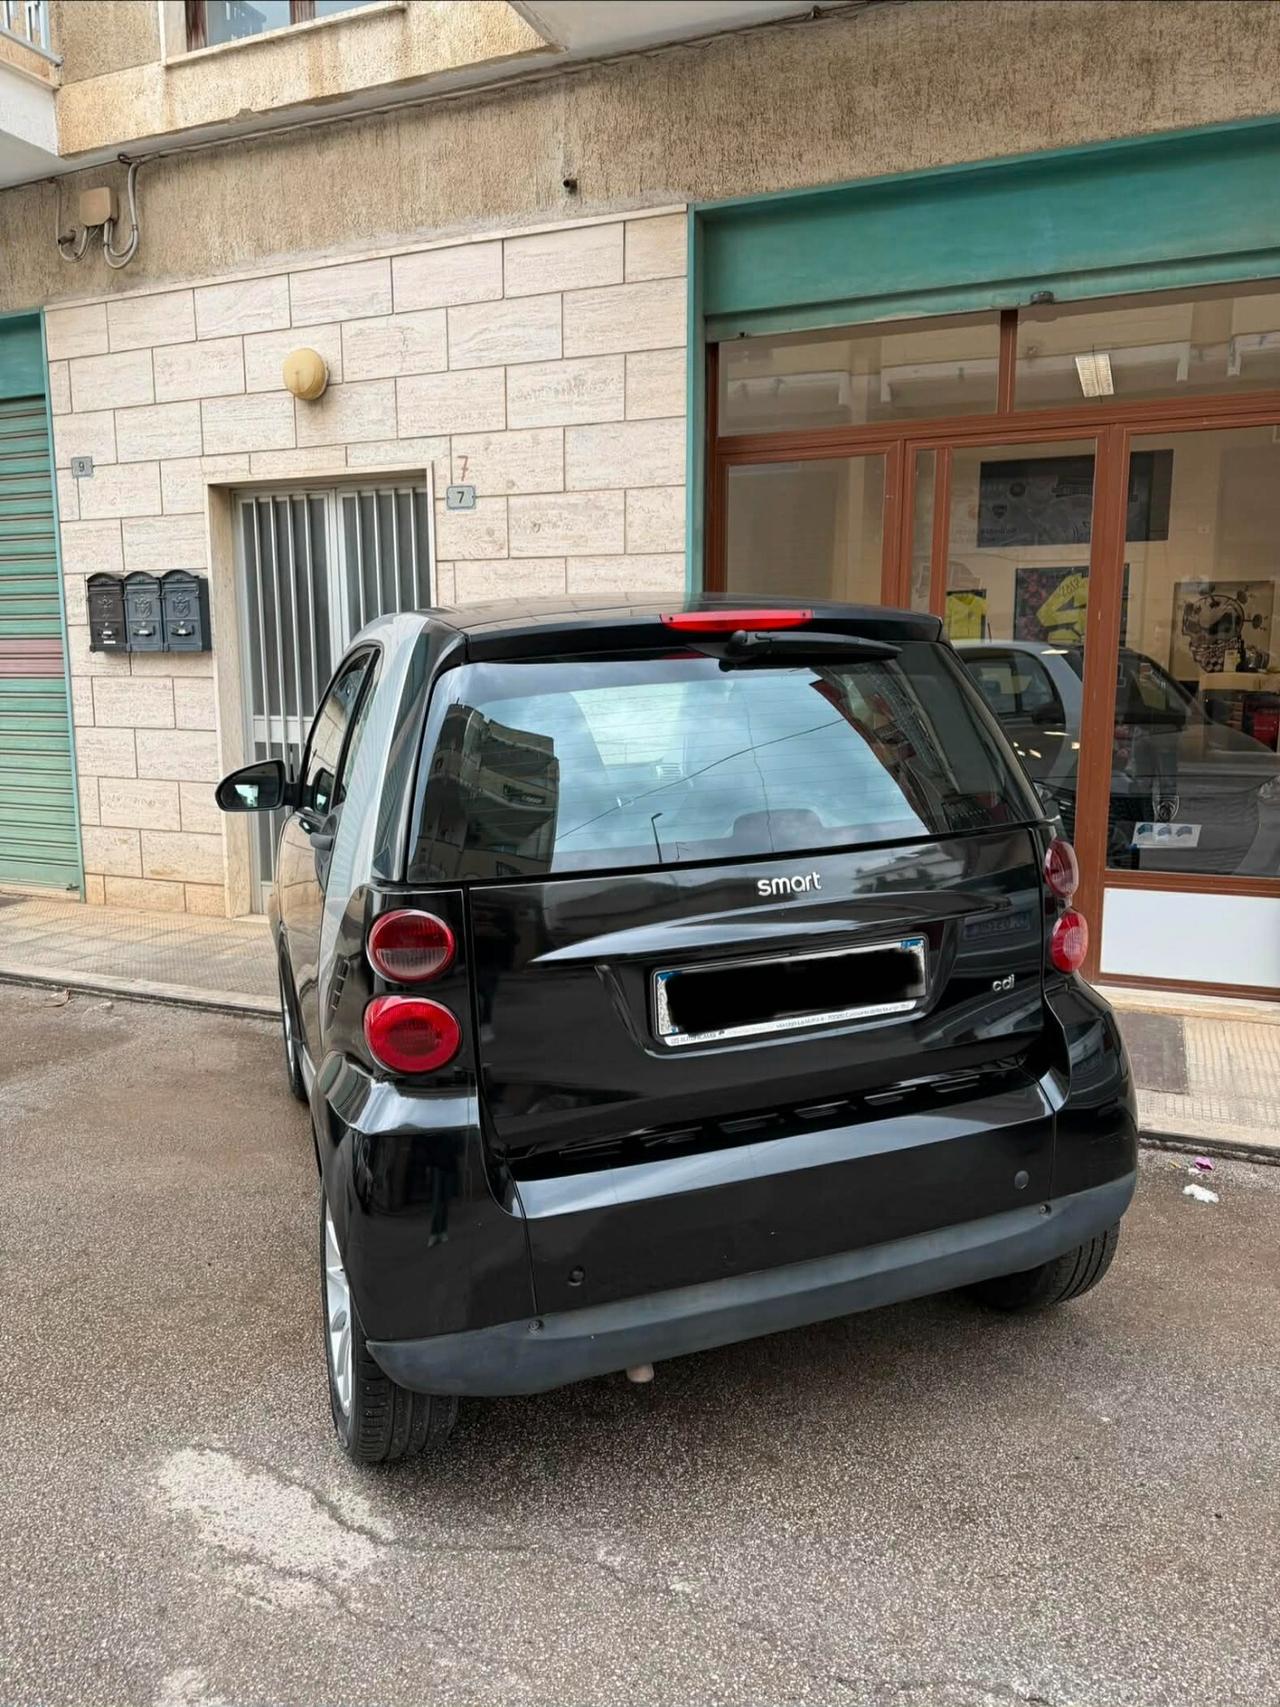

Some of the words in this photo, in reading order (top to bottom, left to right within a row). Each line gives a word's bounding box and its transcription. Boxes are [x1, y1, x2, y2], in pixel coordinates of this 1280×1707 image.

[78, 460, 85, 472] 9
[457, 455, 469, 482] 7
[456, 491, 465, 504] 7
[757, 871, 822, 897] smart
[992, 974, 1015, 992] cdi
